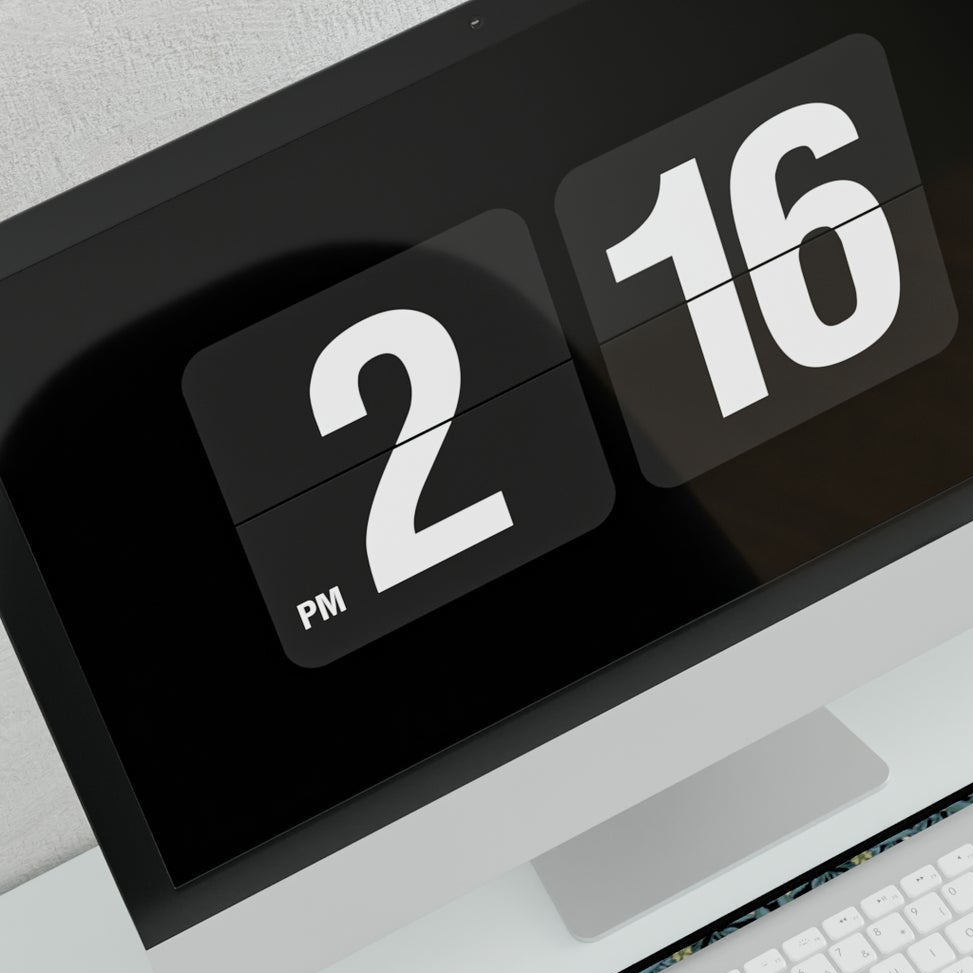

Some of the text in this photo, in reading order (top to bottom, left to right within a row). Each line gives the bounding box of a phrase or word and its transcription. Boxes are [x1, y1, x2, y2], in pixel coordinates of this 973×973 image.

[606, 103, 901, 418] 16
[309, 309, 514, 593] 2
[297, 586, 347, 631] PM
[834, 947, 843, 957] 7
[873, 928, 882, 937] 8
[910, 907, 918, 916] 9
[948, 887, 957, 896] 0
